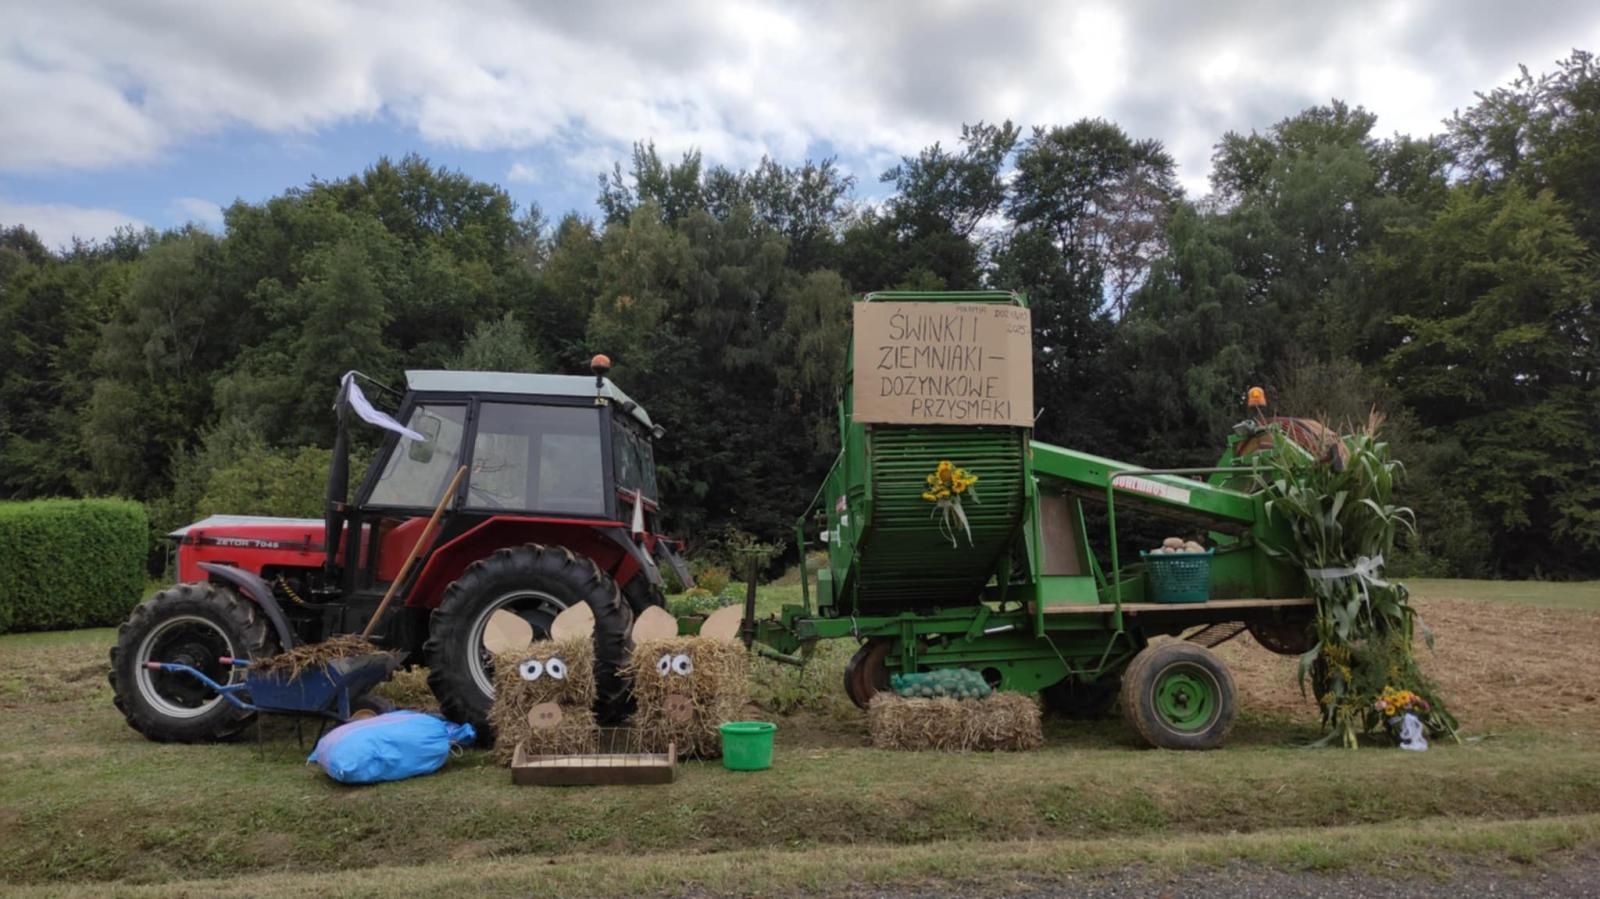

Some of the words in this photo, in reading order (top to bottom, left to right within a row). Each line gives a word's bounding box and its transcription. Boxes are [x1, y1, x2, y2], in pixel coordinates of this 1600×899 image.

[889, 308, 963, 342] ŚWINKI
[973, 315, 978, 342] I
[877, 345, 982, 371] ZIEMNIAKI
[880, 373, 999, 398] DOŻYNKOWE
[911, 399, 1011, 419] PRZYSMAKI
[216, 537, 249, 547] ZETOR
